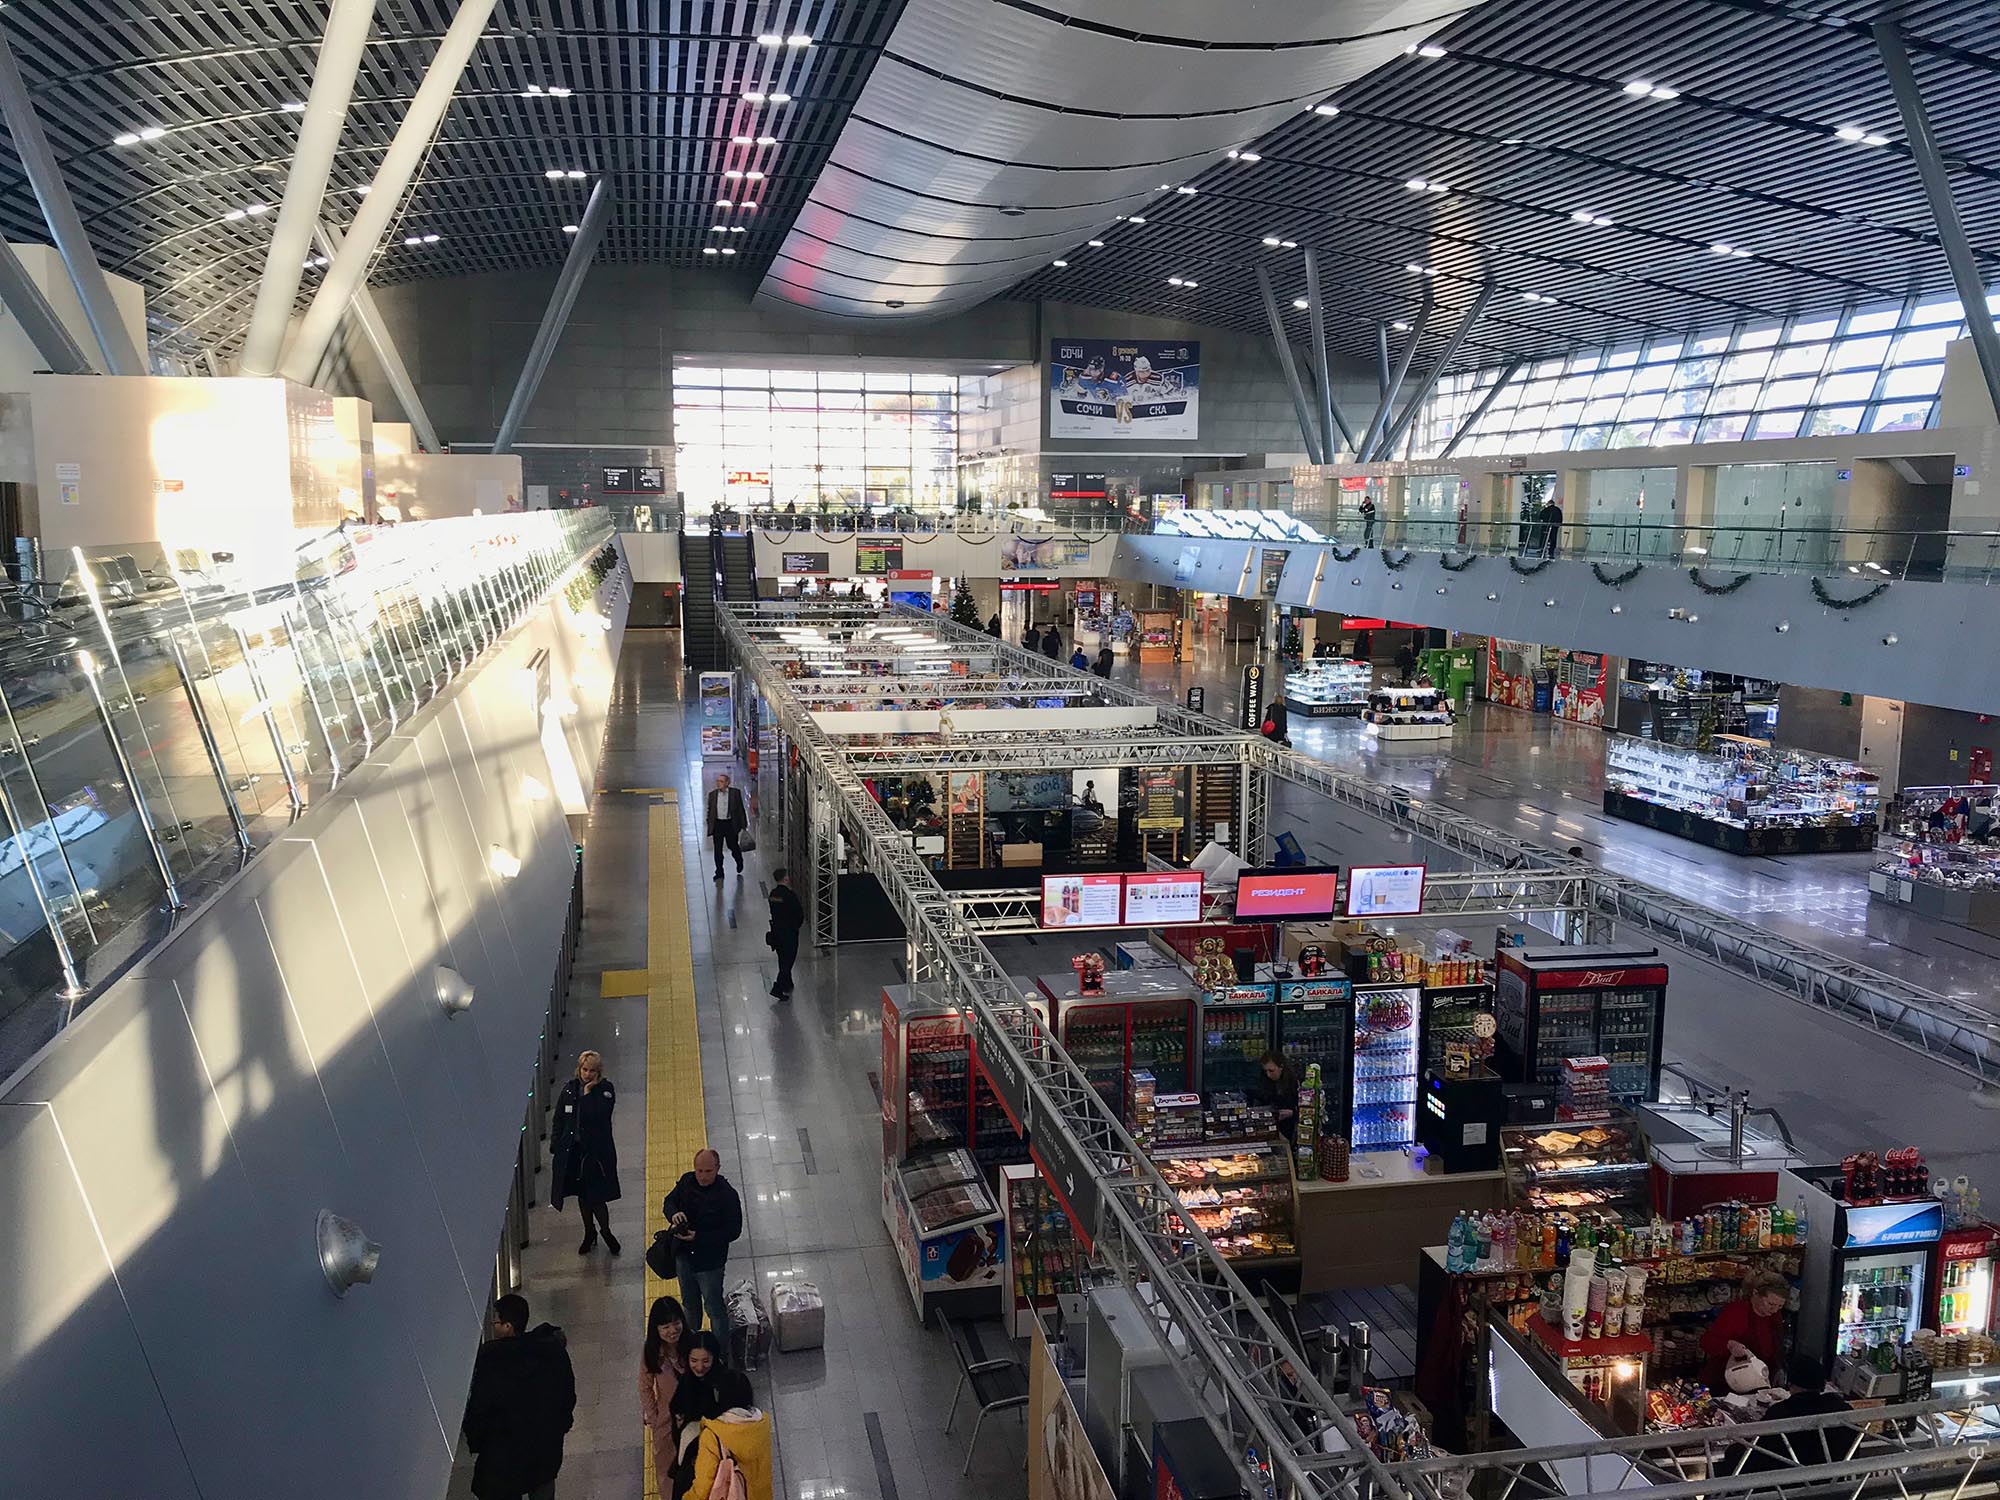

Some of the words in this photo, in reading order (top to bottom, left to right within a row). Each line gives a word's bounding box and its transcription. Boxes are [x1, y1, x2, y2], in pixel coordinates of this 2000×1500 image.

[1060, 348, 1083, 359] СОЧИ
[1076, 403, 1103, 415] СОЧИ
[1115, 400, 1133, 424] VS
[1150, 404, 1167, 415] СКА
[1250, 680, 1258, 697] WAY
[1248, 698, 1256, 727] COFFEE
[1312, 705, 1362, 714] БИЖУТЕРИ
[1033, 778, 1060, 796] 2018
[1251, 888, 1306, 897] РЕЗИДЕНТ
[1589, 972, 1615, 985] Bud
